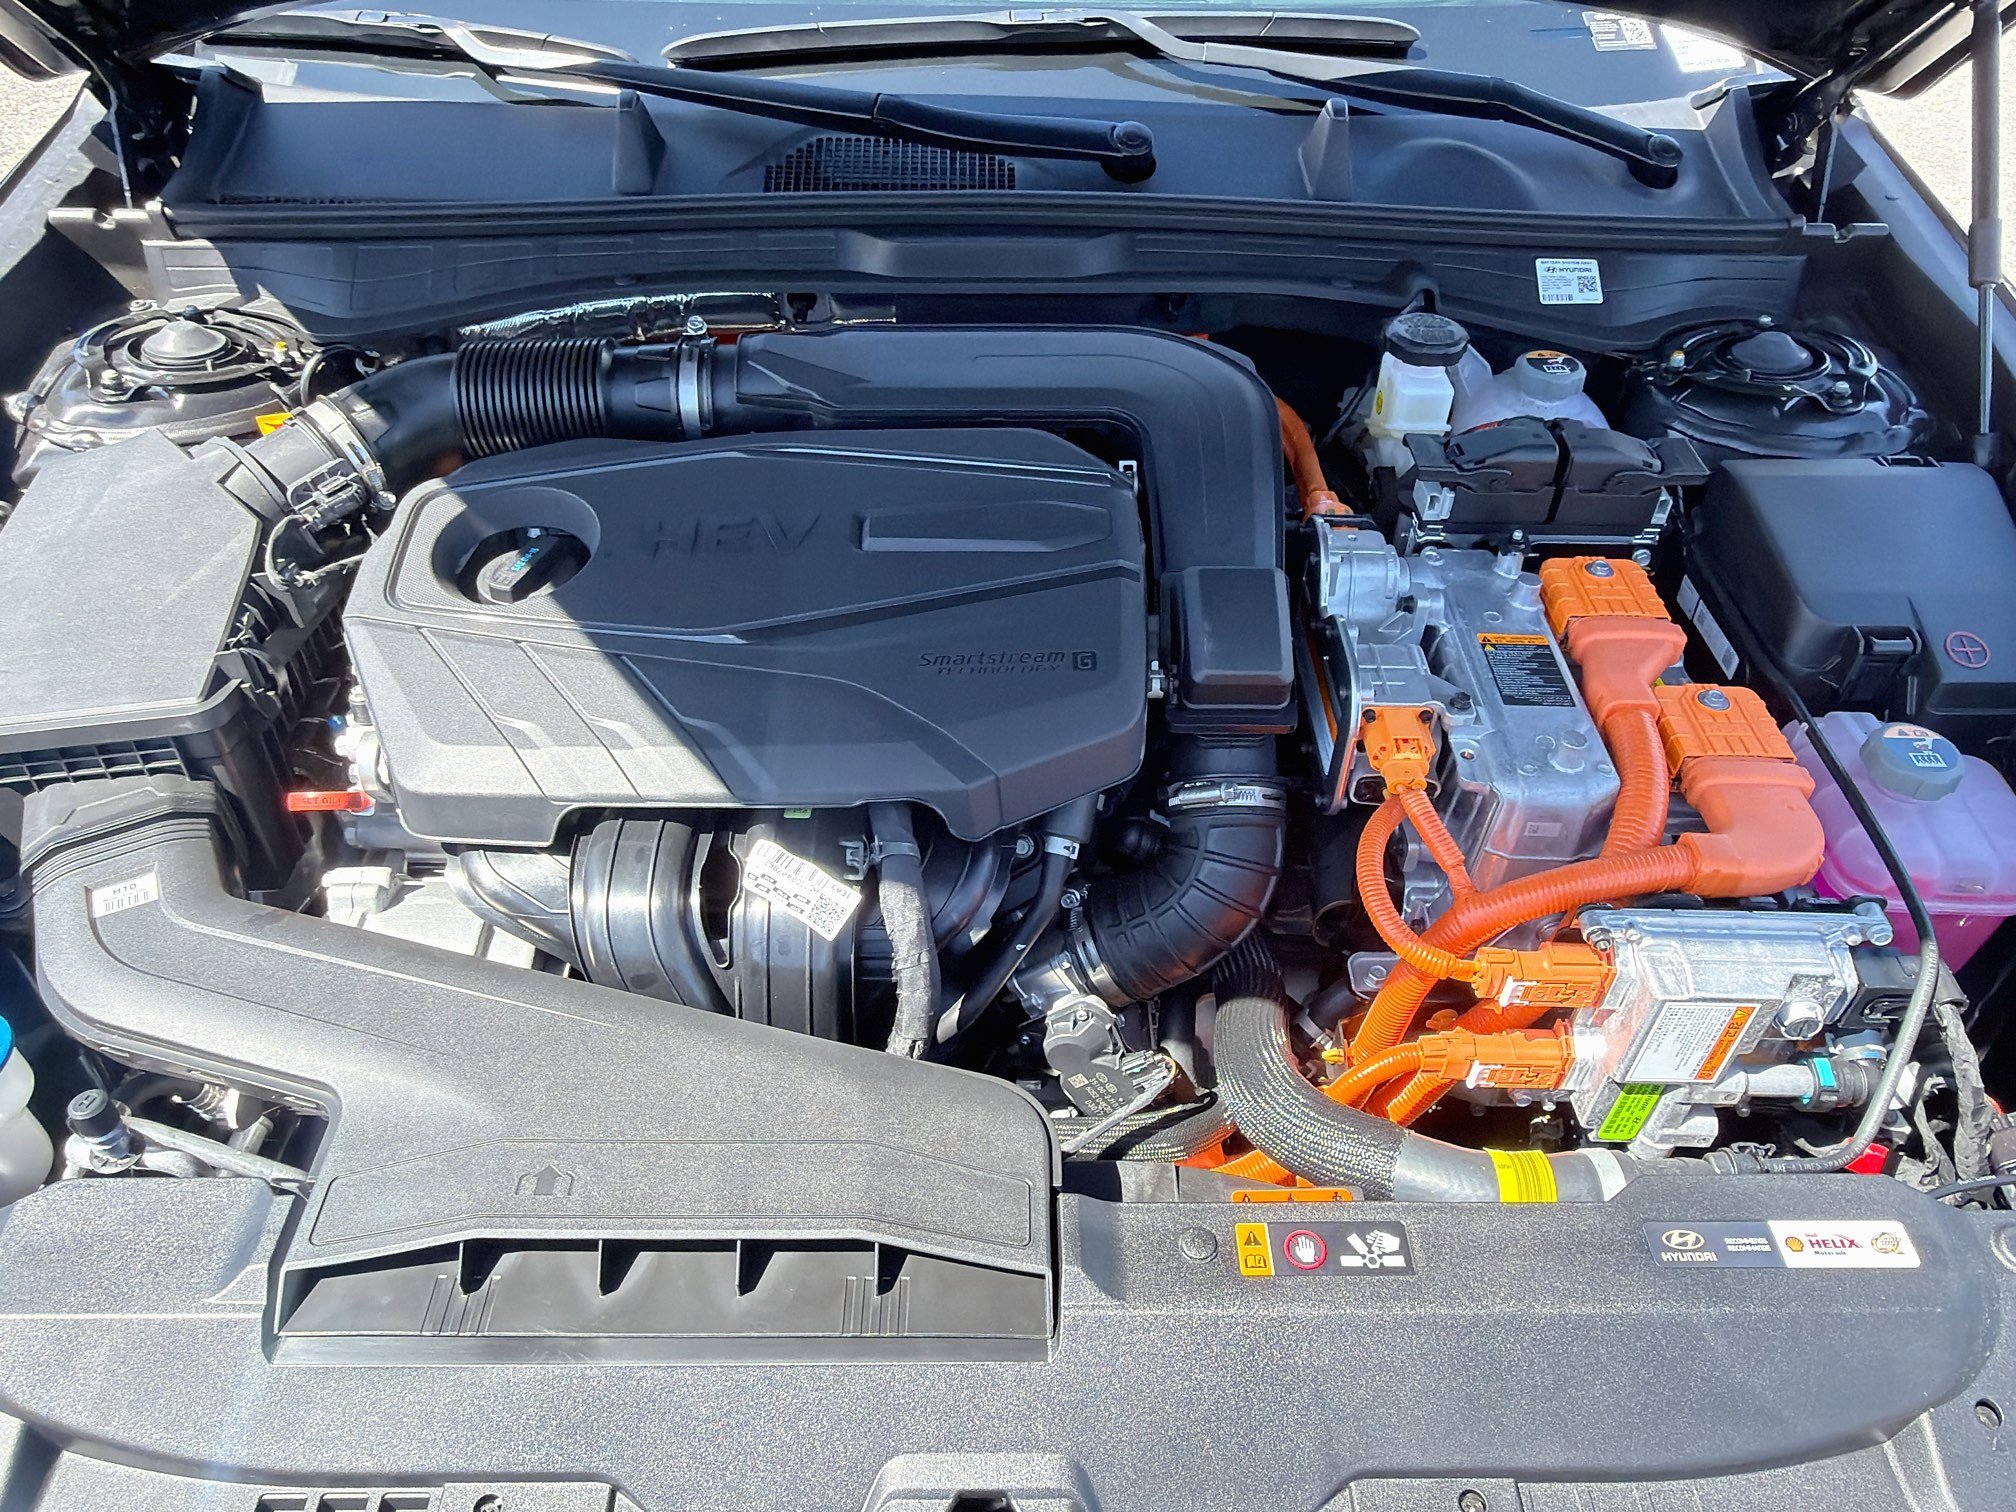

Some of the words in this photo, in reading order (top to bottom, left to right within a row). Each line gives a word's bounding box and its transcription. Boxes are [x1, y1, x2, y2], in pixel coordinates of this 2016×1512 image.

[918, 650, 1065, 667] Smartstream
[113, 883, 137, 895] H10
[1809, 1238, 1862, 1249] HELIX
[1662, 1251, 1718, 1262] HYUNDAI
